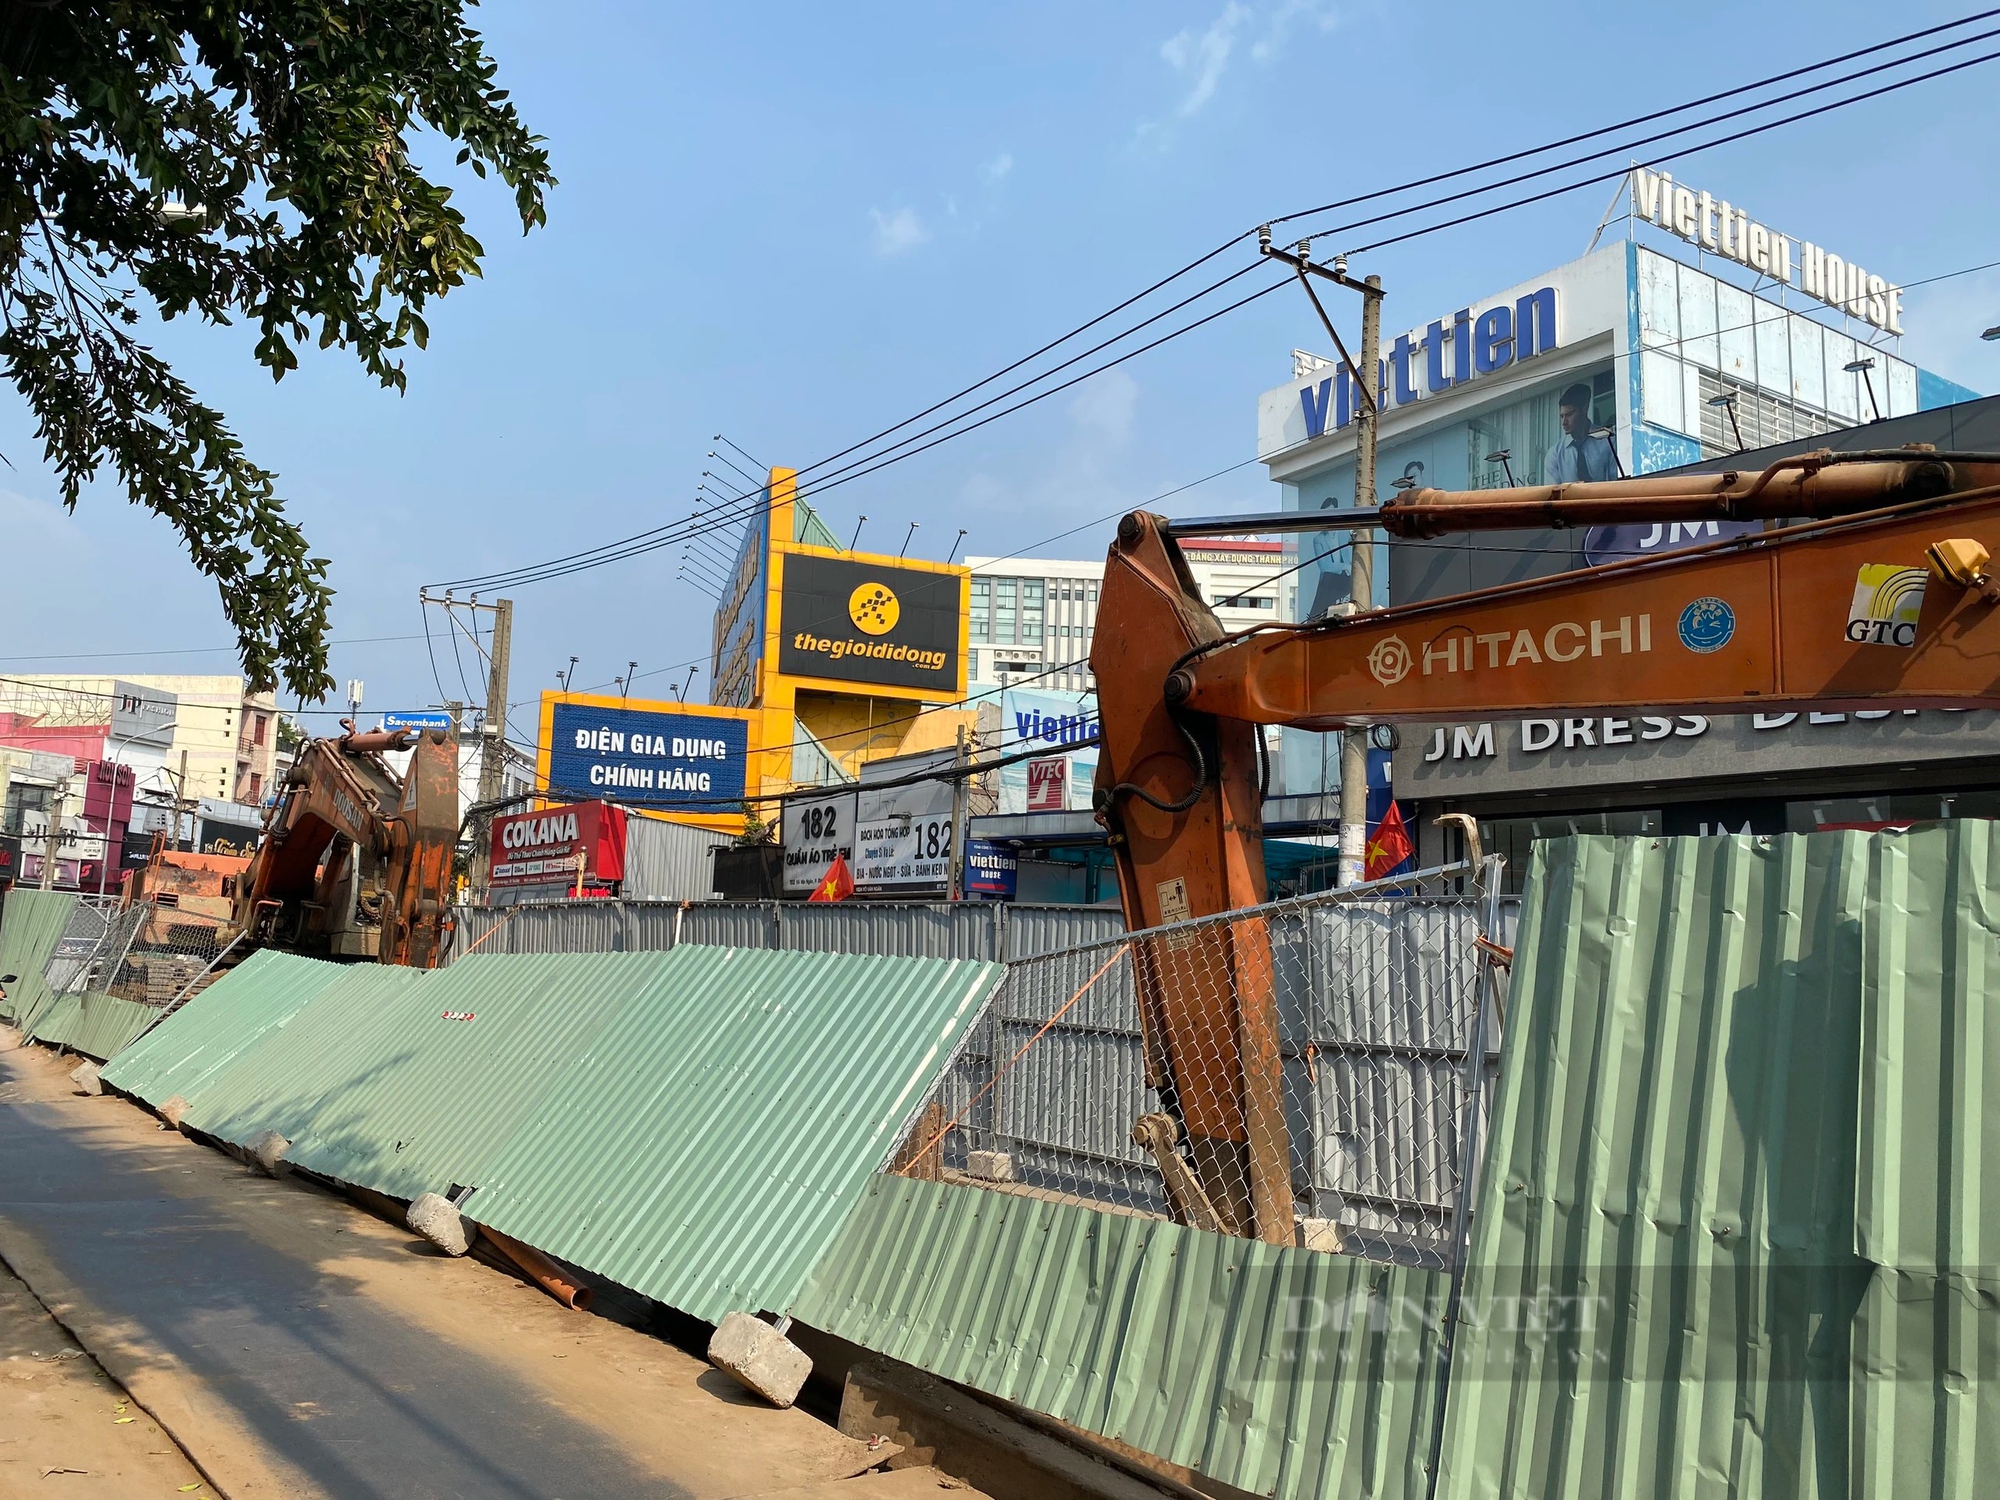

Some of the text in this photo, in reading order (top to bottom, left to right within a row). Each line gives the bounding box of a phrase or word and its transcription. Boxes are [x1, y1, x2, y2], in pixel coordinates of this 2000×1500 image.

[1633, 167, 1905, 337] viettien HOUSE
[1472, 470, 1501, 489] THE
[1422, 613, 1652, 676] HITACHI
[1846, 619, 1917, 647] GTC
[793, 632, 947, 670] thegioididong
[386, 716, 448, 728] Sacombank
[1425, 722, 1497, 763] JM
[1521, 714, 1711, 752] DRESS
[575, 728, 727, 761] ĐIỆN GIA DỤNG
[590, 765, 711, 792] CHÍNH HÃNG
[1029, 760, 1065, 783] VTEC
[333, 788, 365, 831] DOOSAN
[801, 805, 837, 840] 182
[502, 813, 580, 849] COKANA
[914, 820, 952, 860] 182
[931, 864, 943, 878] KẸO
[969, 853, 1016, 870] viettien
[981, 870, 1001, 879] HOUSE
